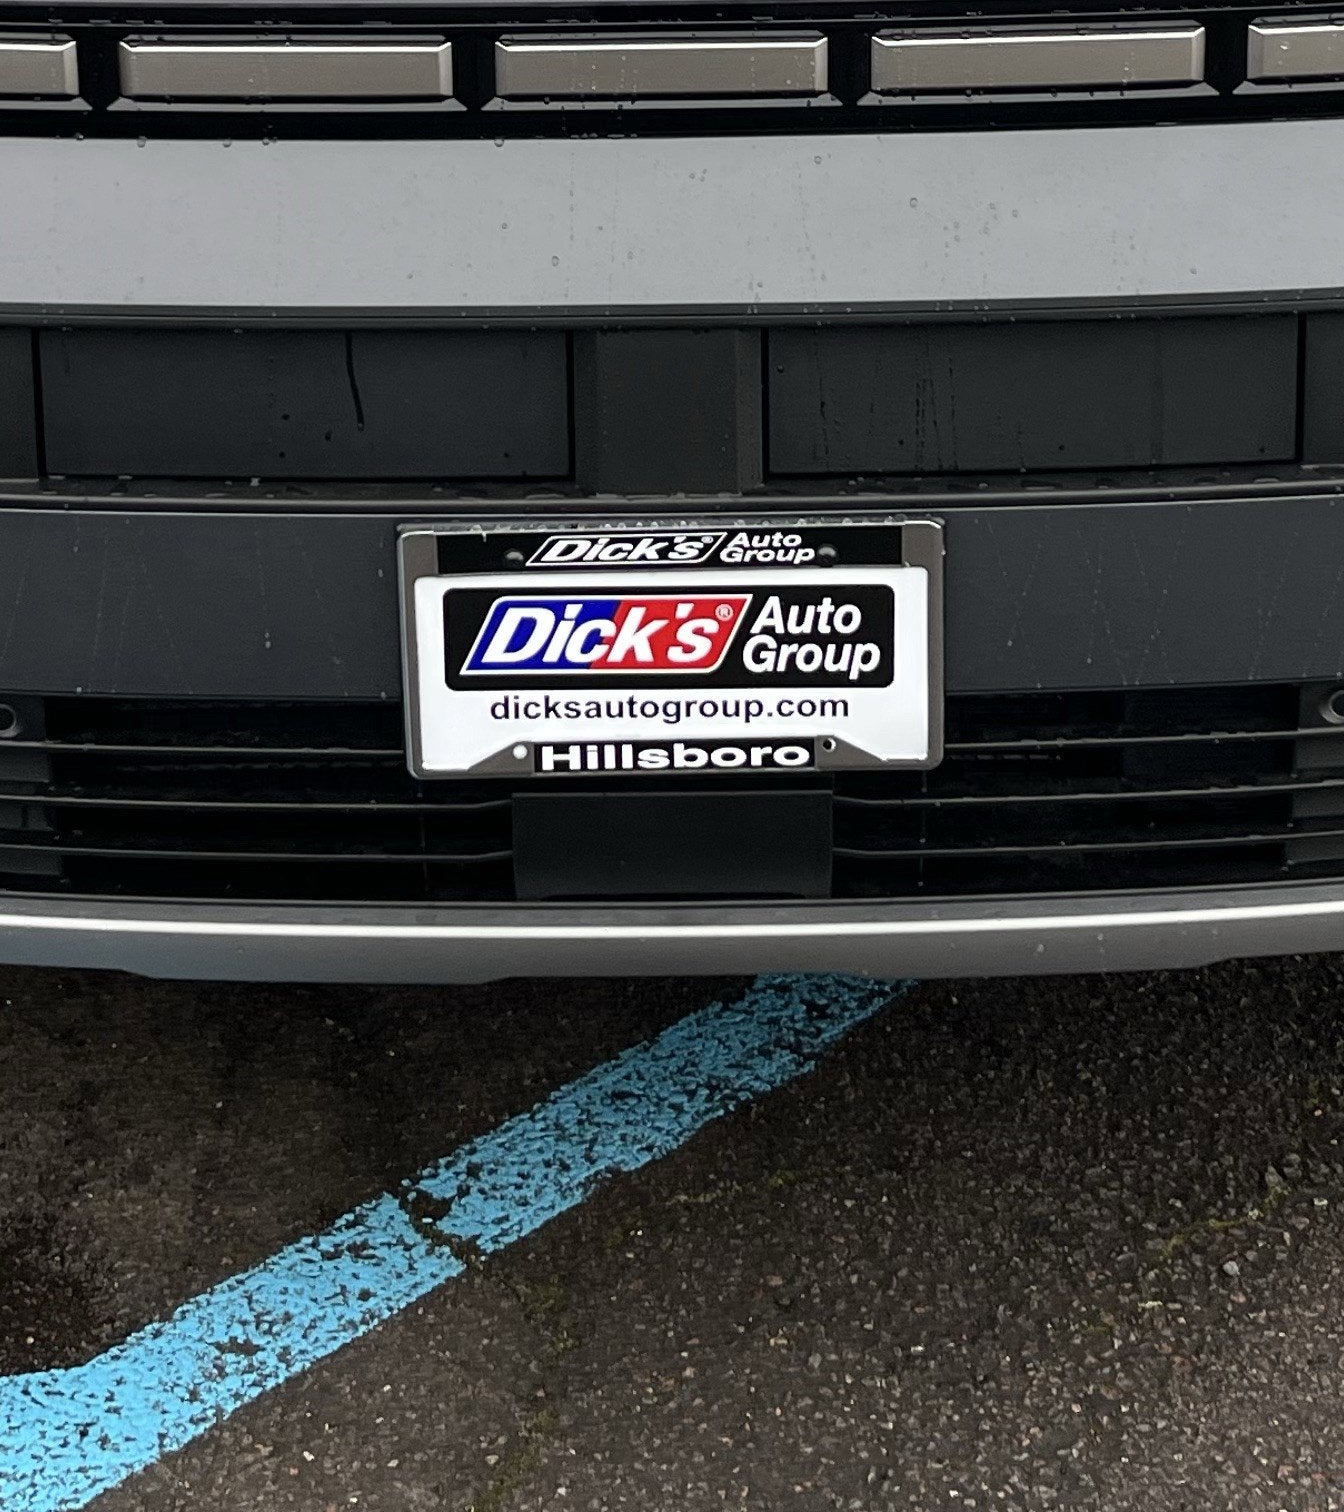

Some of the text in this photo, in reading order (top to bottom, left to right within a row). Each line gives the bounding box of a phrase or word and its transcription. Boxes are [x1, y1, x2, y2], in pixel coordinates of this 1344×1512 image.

[727, 532, 802, 549] Auto
[720, 546, 815, 565] Group
[750, 595, 862, 636] Auto
[742, 634, 882, 680] Group
[490, 694, 850, 725] dicksautogroup.com
[541, 743, 811, 771] Hillsboro
